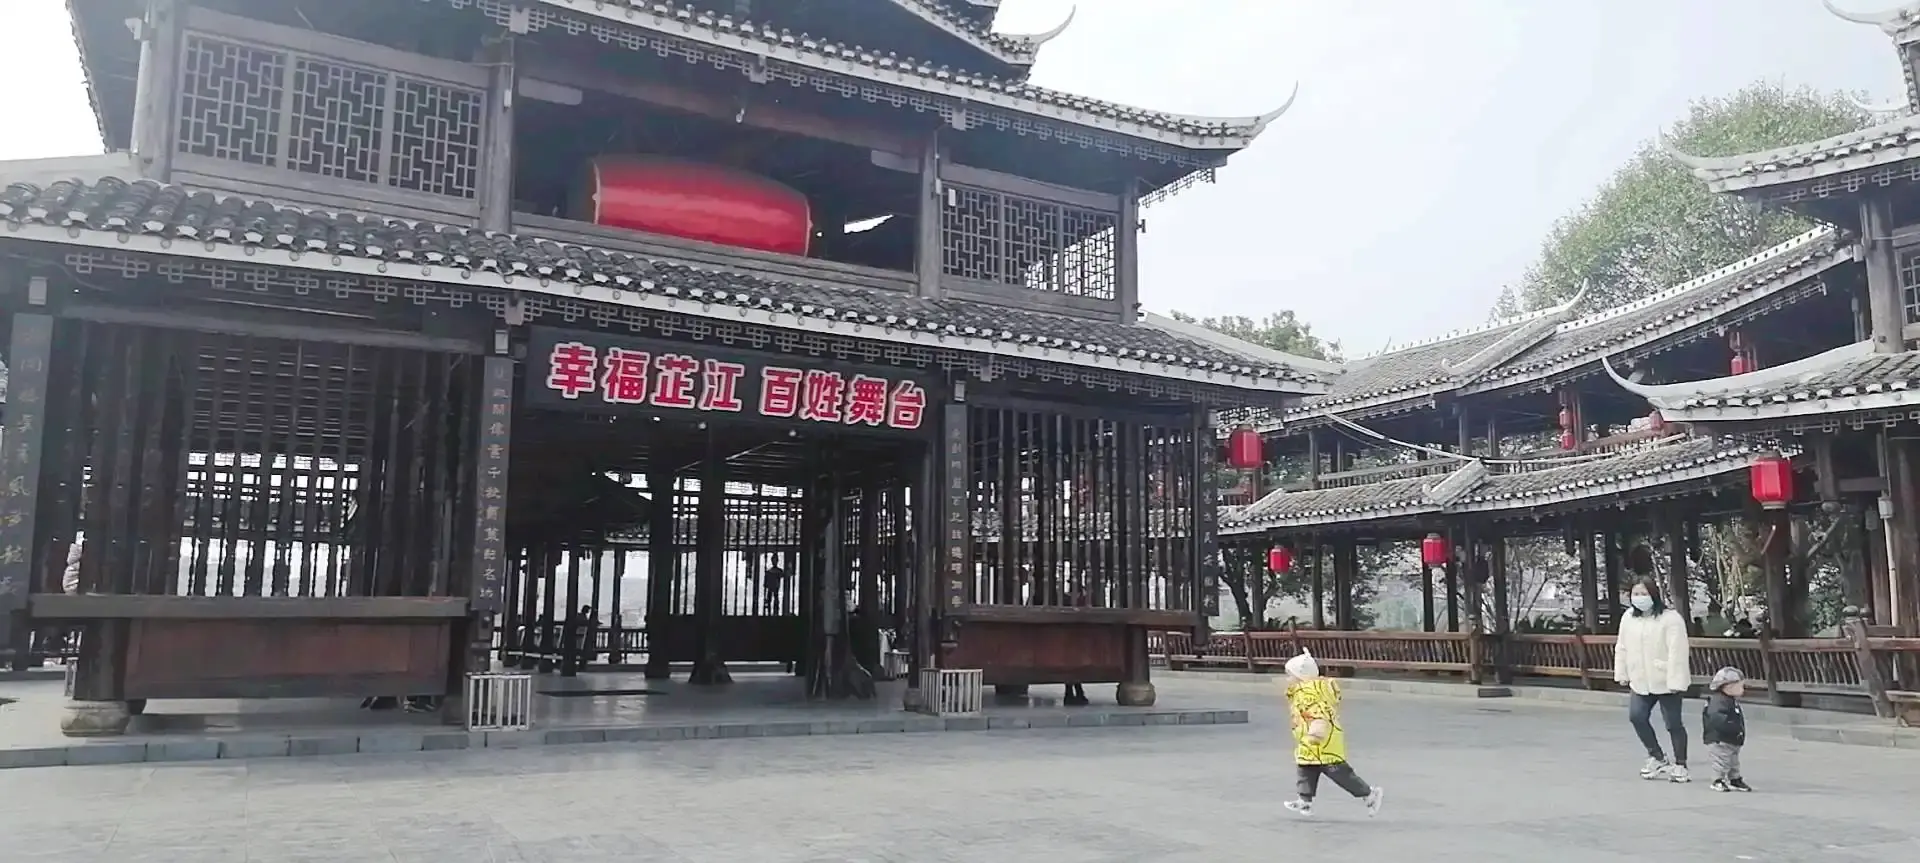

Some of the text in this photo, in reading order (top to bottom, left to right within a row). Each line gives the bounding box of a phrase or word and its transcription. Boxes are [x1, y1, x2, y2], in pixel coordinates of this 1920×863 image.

[547, 342, 927, 430] 幸福芷江 百姓舞台
